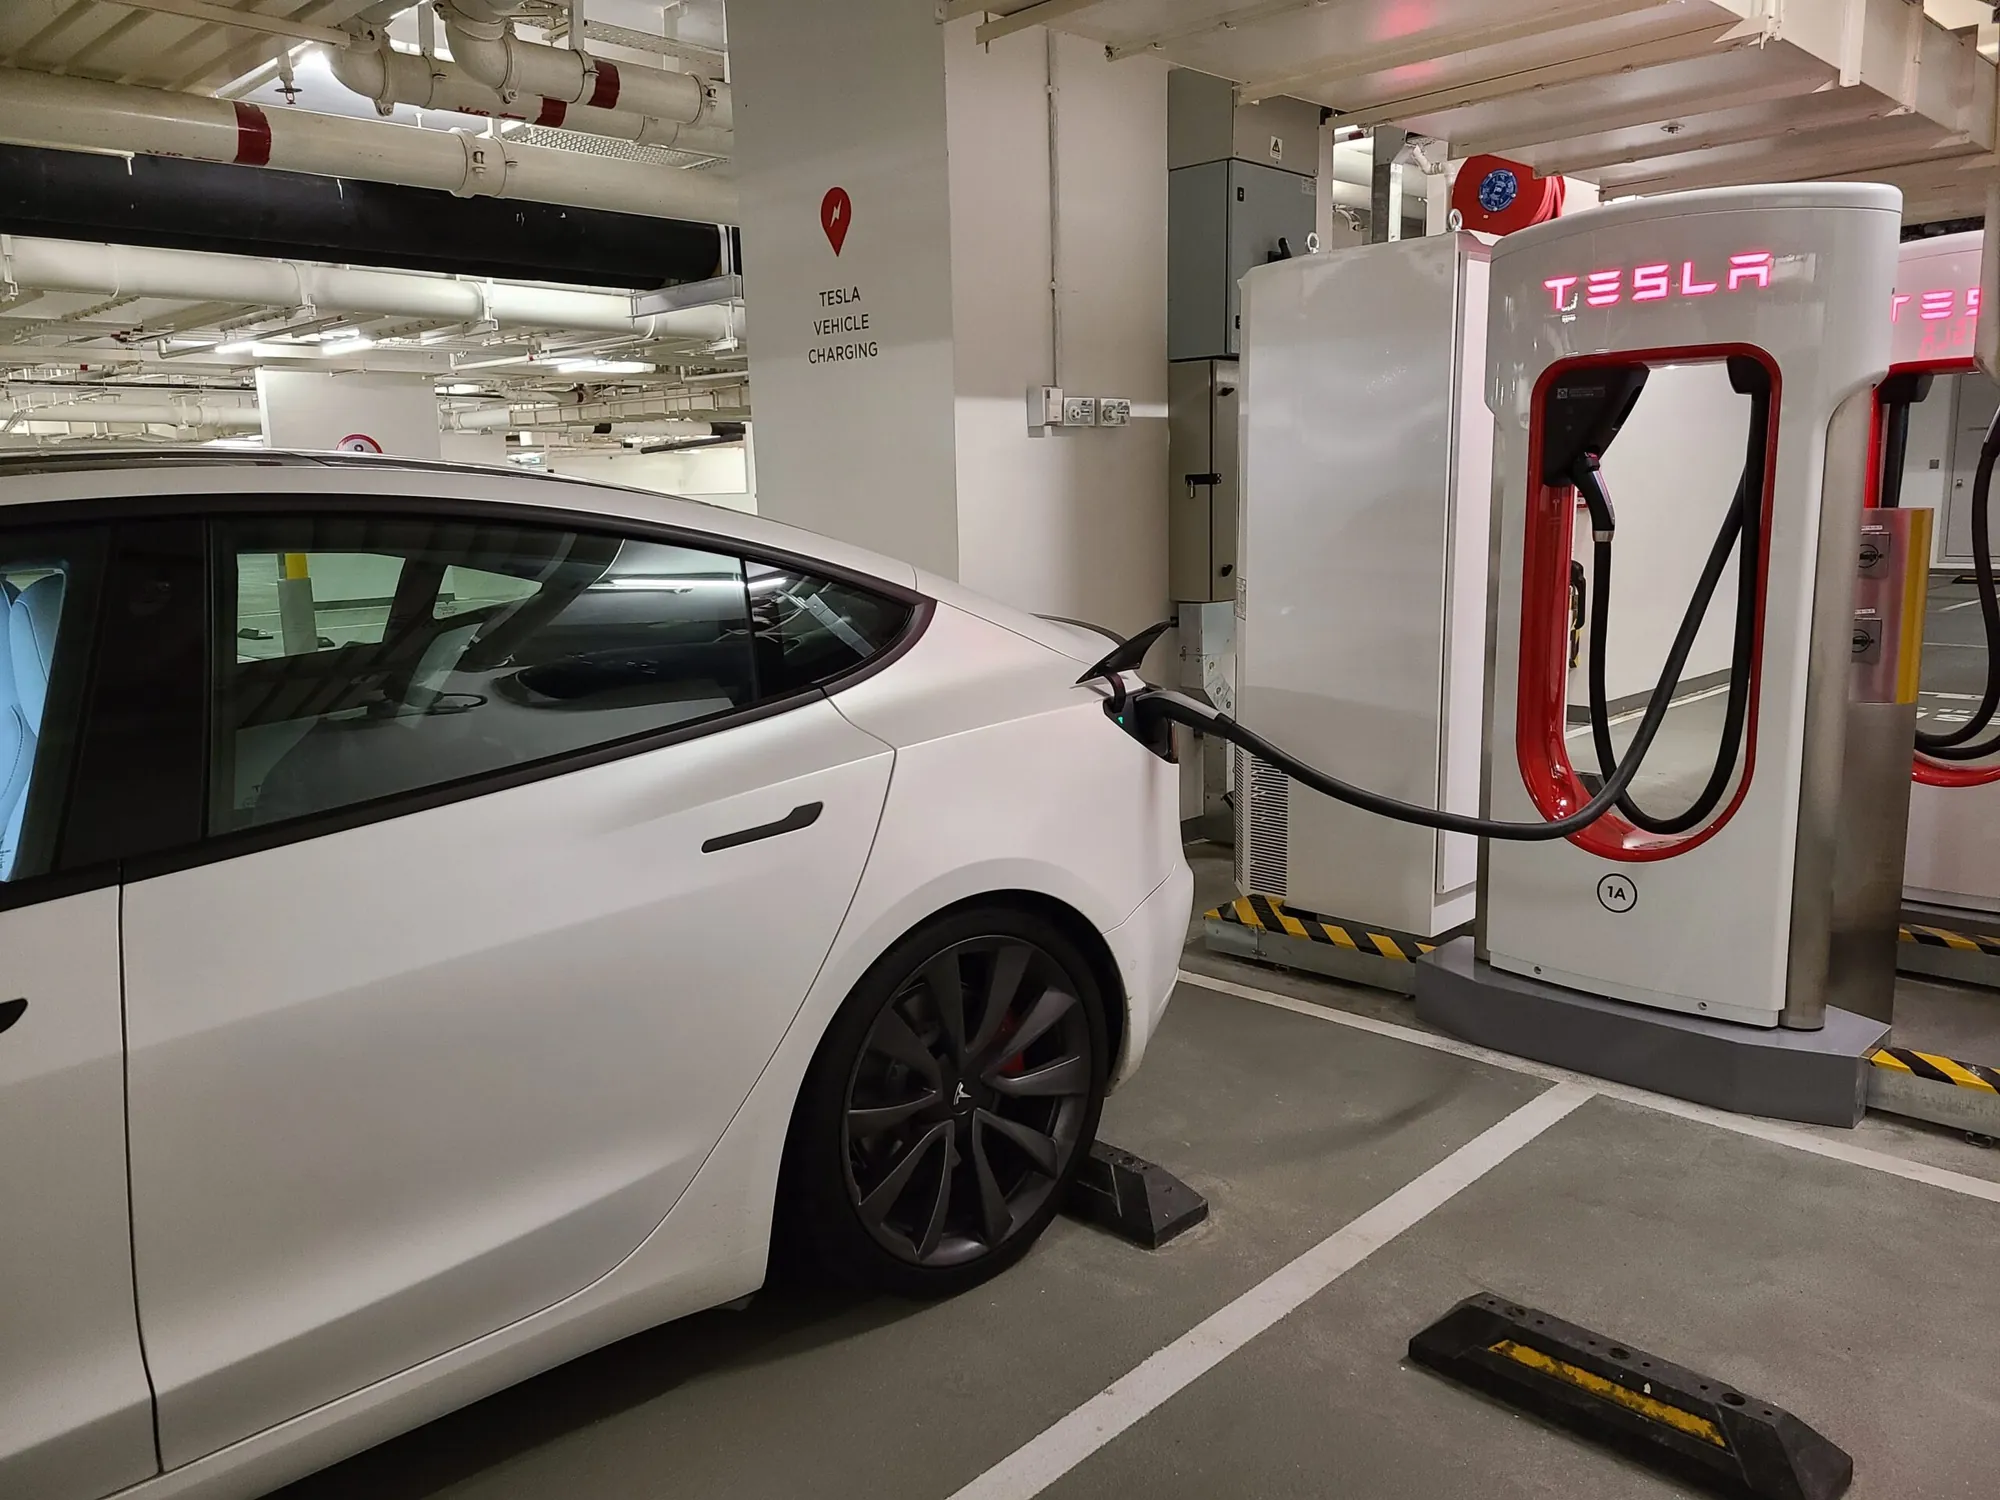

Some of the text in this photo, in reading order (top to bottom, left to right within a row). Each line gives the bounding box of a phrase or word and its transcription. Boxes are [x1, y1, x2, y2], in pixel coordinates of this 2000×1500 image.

[1544, 252, 1772, 310] TESLA
[818, 286, 861, 307] TESLA
[813, 313, 870, 336] VEHICLE
[808, 341, 878, 364] CHARGING
[1607, 885, 1626, 901] 1A
